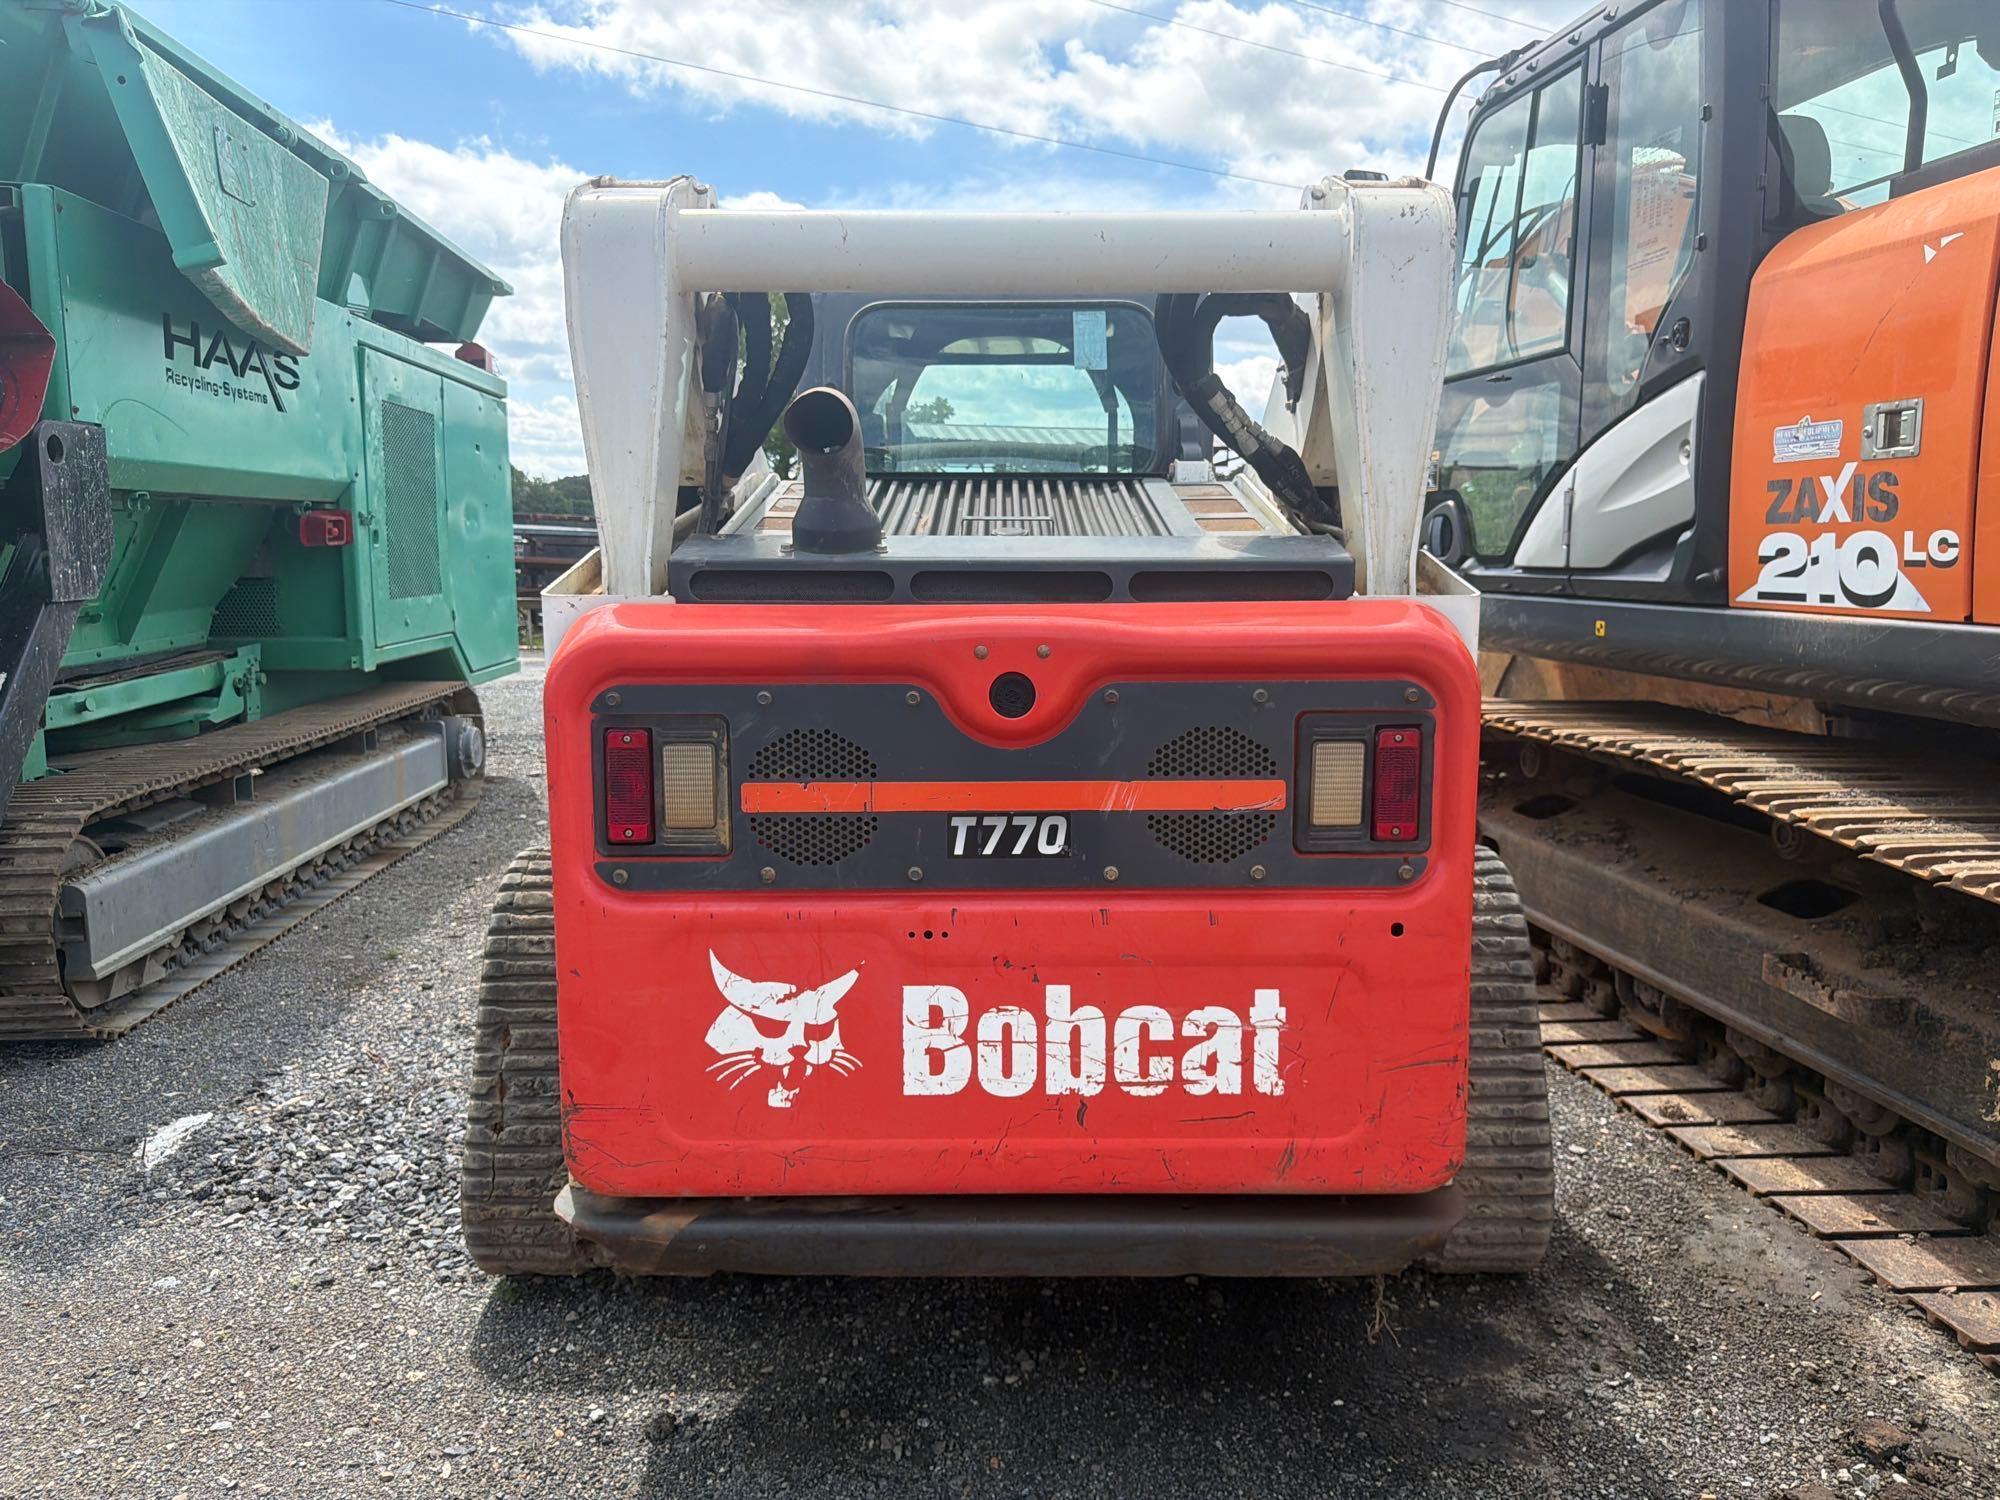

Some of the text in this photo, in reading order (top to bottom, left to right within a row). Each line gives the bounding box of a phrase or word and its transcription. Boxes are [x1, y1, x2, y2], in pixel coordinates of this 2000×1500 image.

[162, 312, 300, 413] HAAS
[165, 367, 269, 403] Recycling-Systems
[1765, 462, 1899, 524] ZAXIS
[1757, 529, 1960, 607] 210 LC
[951, 815, 1067, 856] T770
[902, 984, 1286, 1098] Bobcat
